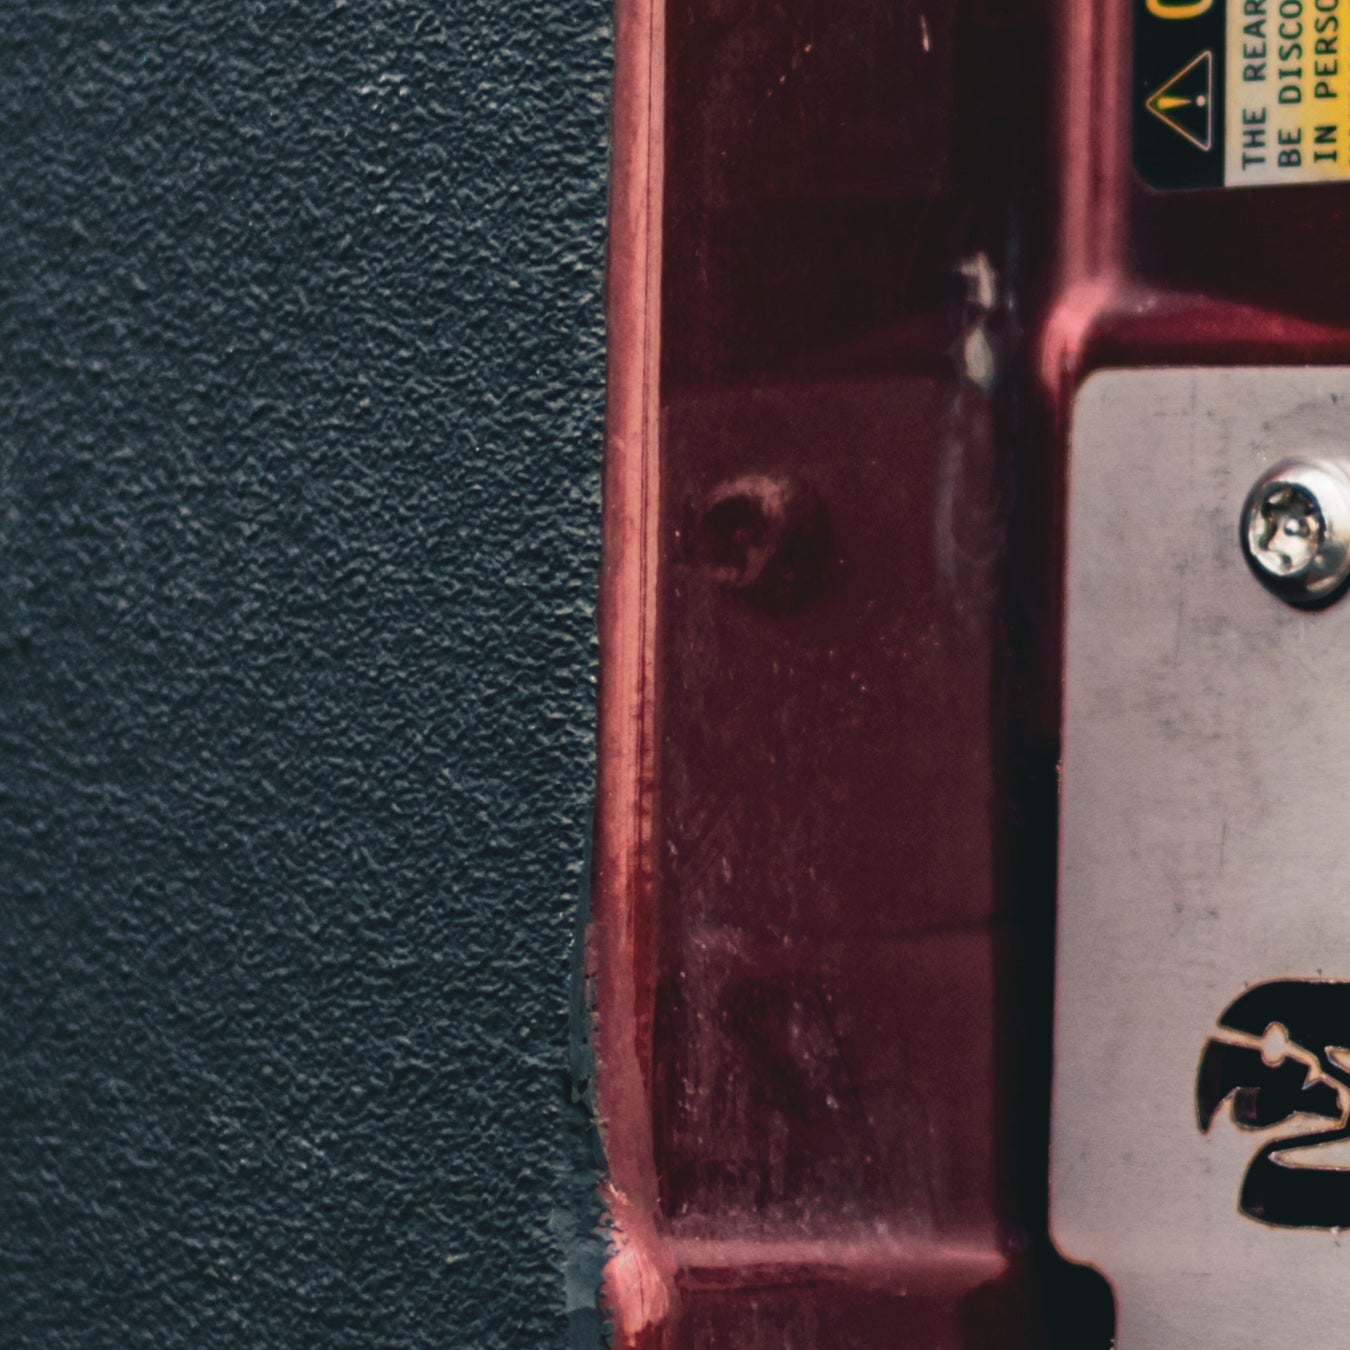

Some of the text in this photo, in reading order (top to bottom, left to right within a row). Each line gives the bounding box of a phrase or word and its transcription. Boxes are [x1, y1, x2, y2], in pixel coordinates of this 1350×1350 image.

[1242, 0, 1267, 171] THE REAR
[1278, 0, 1303, 167] BE DISCO
[1313, 126, 1338, 163] IN
